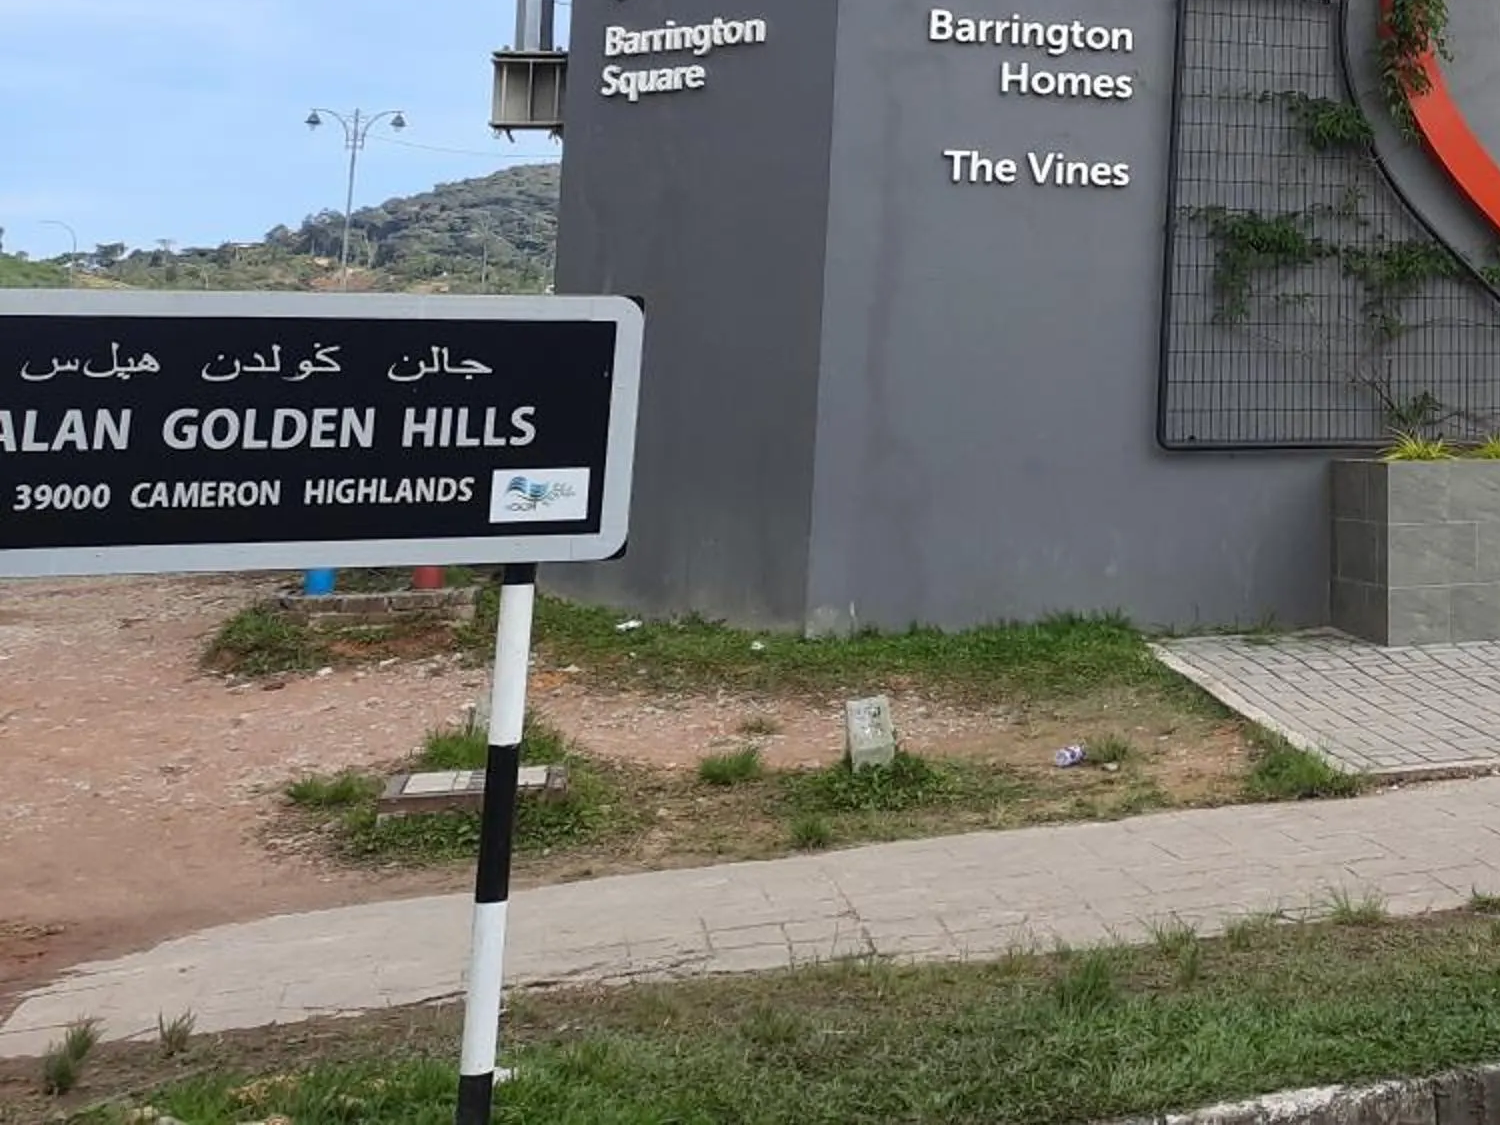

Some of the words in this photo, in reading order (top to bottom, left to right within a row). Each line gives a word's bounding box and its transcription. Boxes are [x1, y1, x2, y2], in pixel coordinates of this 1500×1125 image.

[604, 16, 767, 56] Barrington
[930, 8, 1134, 56] Barrington
[601, 64, 706, 102] Square
[1001, 62, 1133, 99] Homes
[944, 149, 1017, 183] The
[1027, 151, 1130, 187] Vines
[163, 407, 375, 450] GOLDEN
[402, 406, 537, 447] HILLS
[13, 483, 111, 511] 39000
[130, 480, 281, 508] CAMERON
[303, 476, 475, 505] HIGHLANDS
